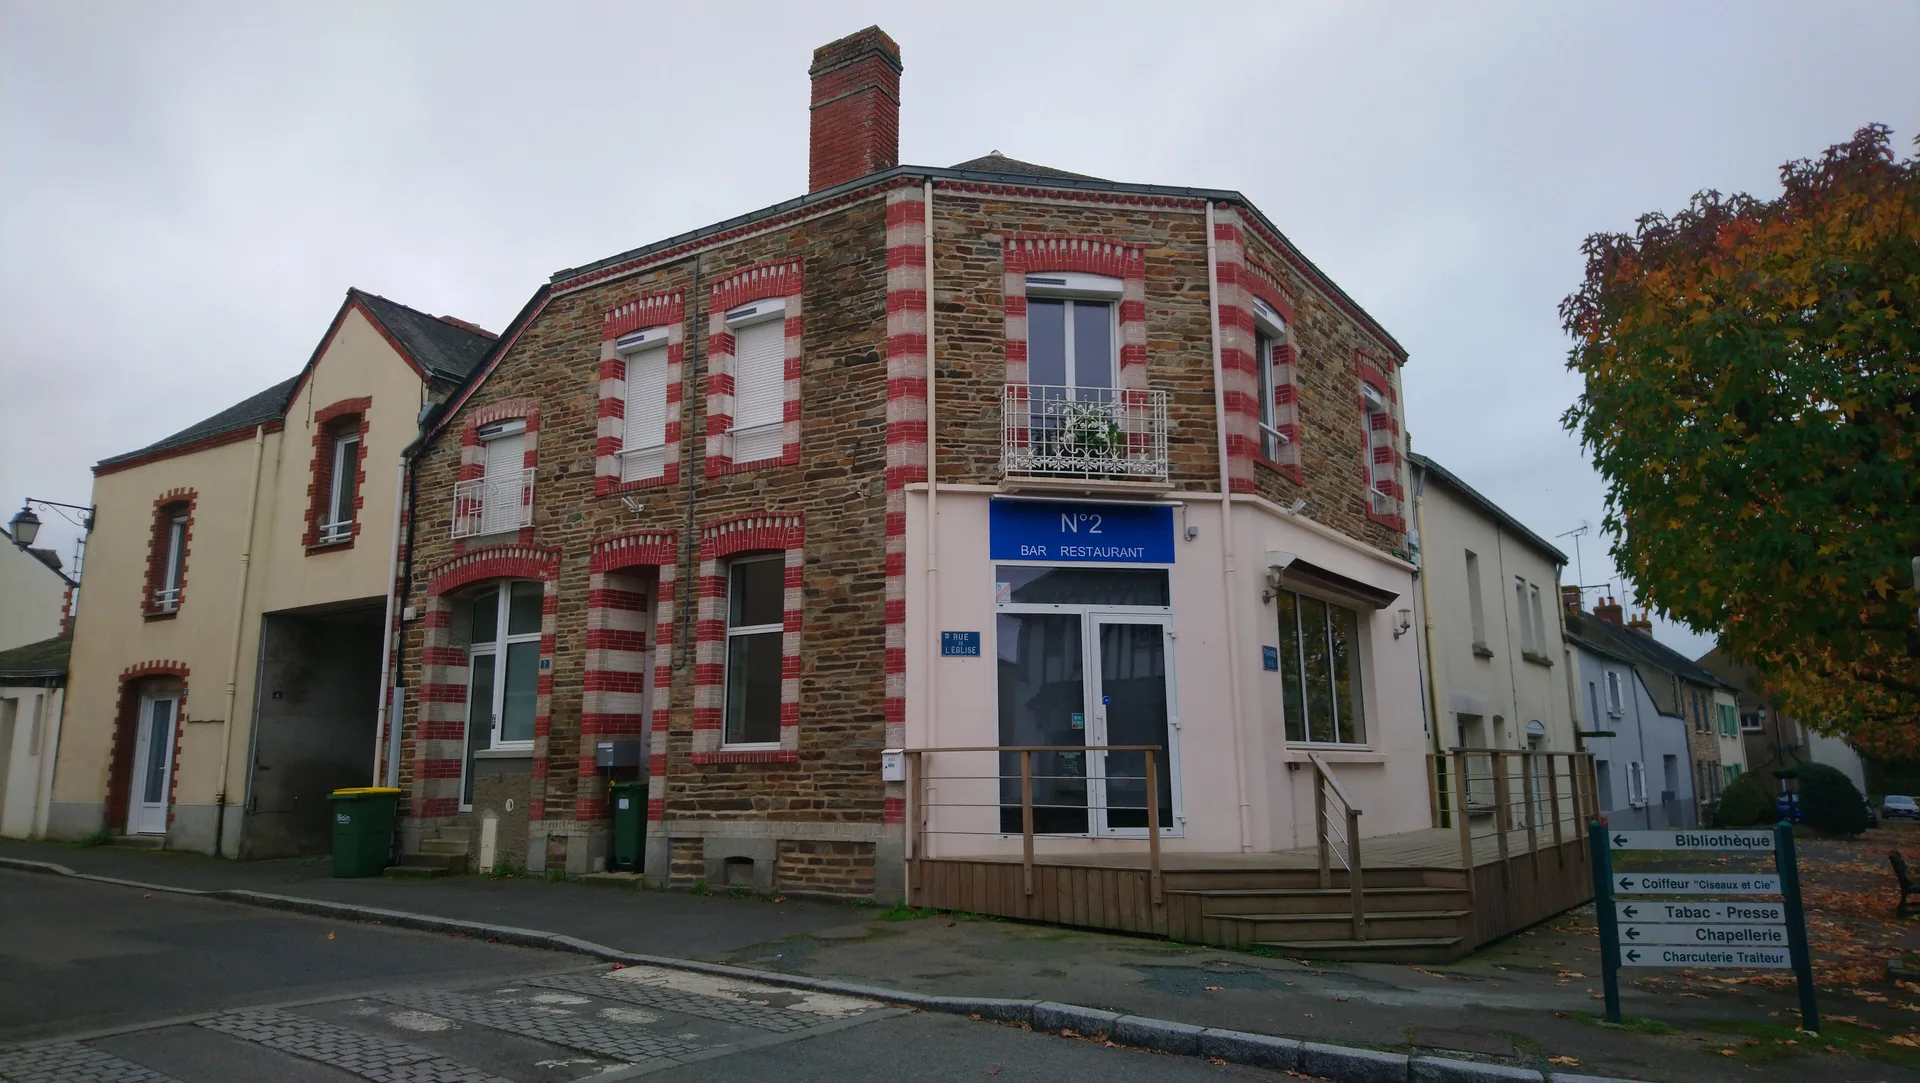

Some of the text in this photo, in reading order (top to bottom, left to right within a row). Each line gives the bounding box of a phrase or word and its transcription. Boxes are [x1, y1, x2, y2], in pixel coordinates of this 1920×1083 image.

[1061, 513, 1103, 534] N°2
[1020, 545, 1144, 558] BAR RESTAURANT
[953, 633, 969, 641] RUE
[1675, 834, 1770, 849] Bibliothèque
[1642, 878, 1775, 890] Coiffeur "Ciseaux et Cie"
[1665, 906, 1710, 919] Tabac
[1727, 906, 1779, 919] Presse
[1696, 928, 1782, 944] Chapellerie
[1663, 951, 1784, 964] Charcuterie Traiteur
